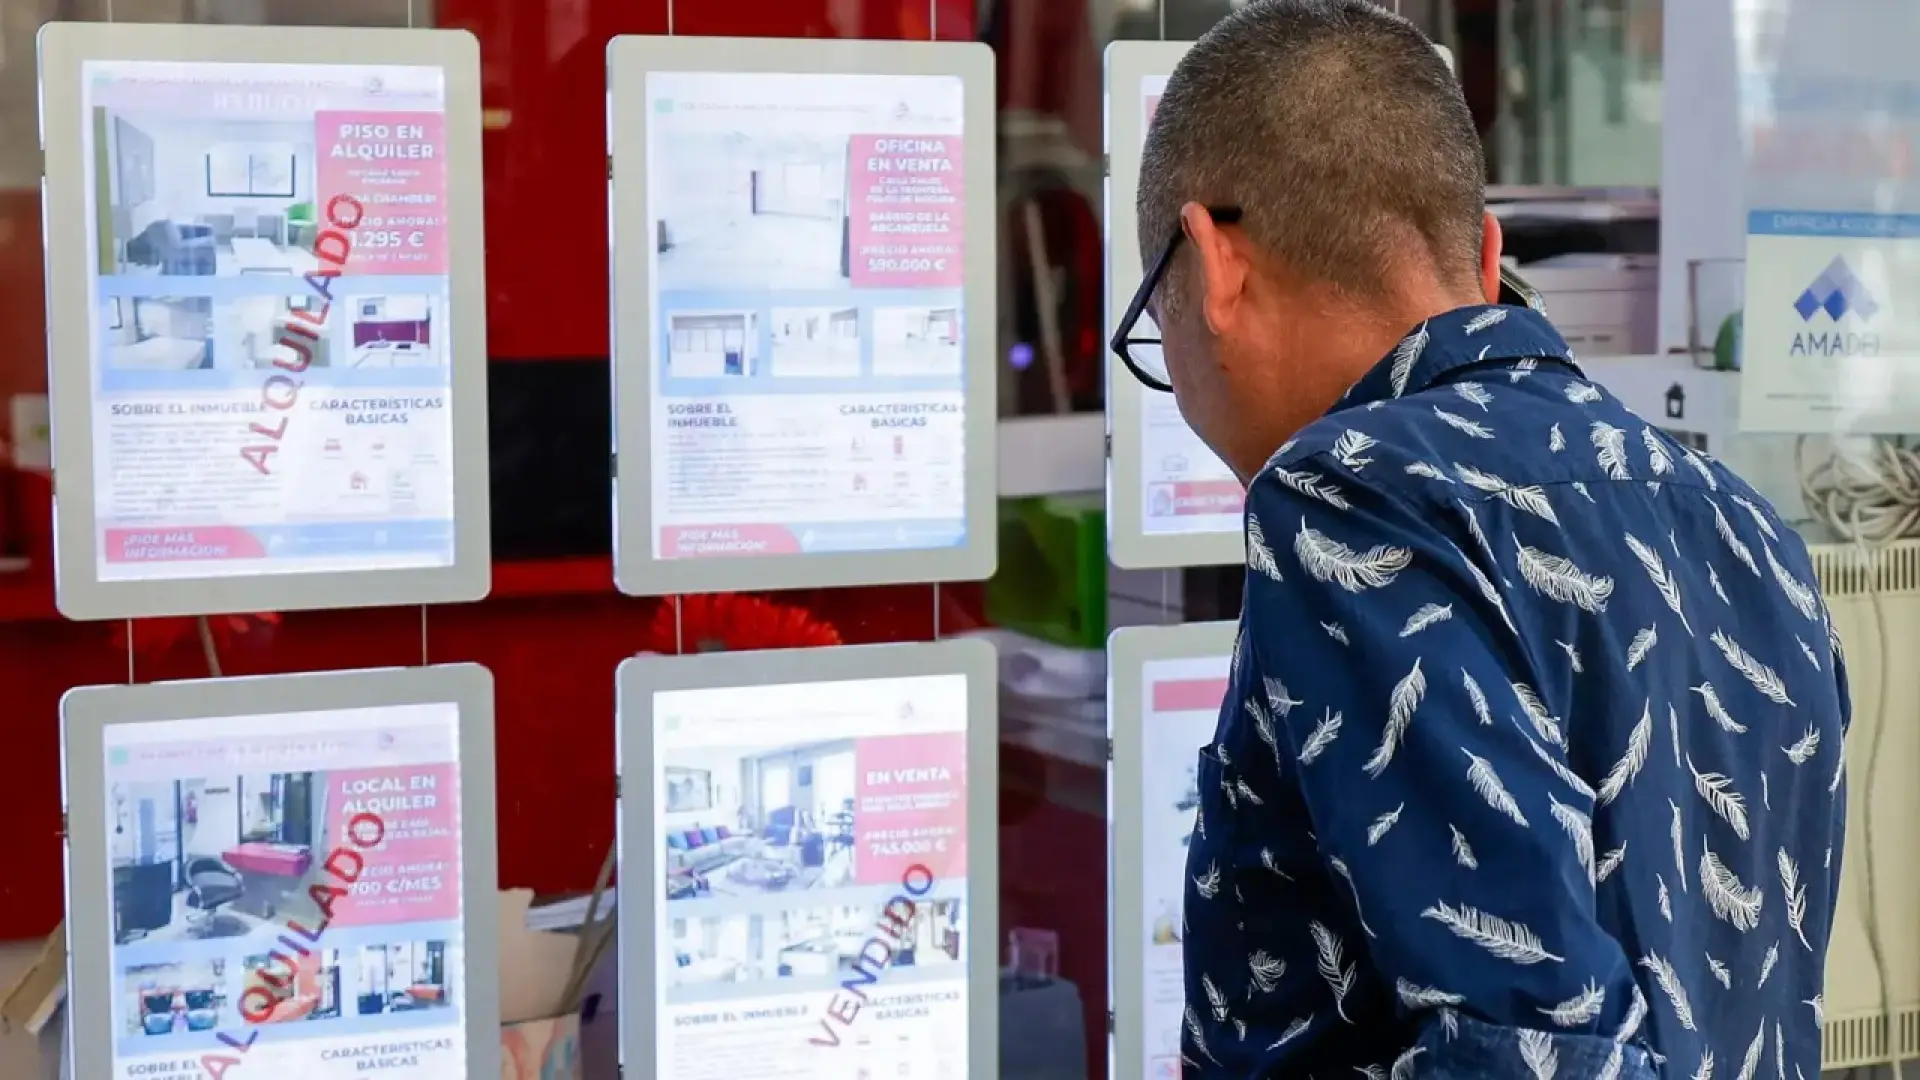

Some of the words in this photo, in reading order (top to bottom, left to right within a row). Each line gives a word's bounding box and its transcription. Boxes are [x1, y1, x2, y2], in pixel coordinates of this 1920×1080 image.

[340, 124, 390, 139] PISO
[396, 125, 424, 139] EN
[330, 143, 434, 161] ALQUILER
[874, 138, 946, 154] OFICINA
[867, 157, 891, 172] EN
[895, 157, 953, 172] VENTA
[347, 230, 402, 248] 1.295
[407, 231, 425, 248] €
[933, 257, 948, 272] €
[240, 193, 363, 475] ALQUILADO
[111, 402, 162, 415] SOBRE
[168, 402, 188, 415] EL
[667, 402, 712, 415] SOBRE
[716, 402, 733, 414] EL
[341, 777, 405, 795] LOCAL
[410, 775, 436, 790] EN
[866, 770, 891, 787] EN
[893, 766, 951, 785] VENTA
[341, 794, 437, 815] ALQUILER
[934, 837, 949, 854] €
[201, 812, 385, 1080] ALQUILADO
[808, 863, 934, 1049] VENDIDO
